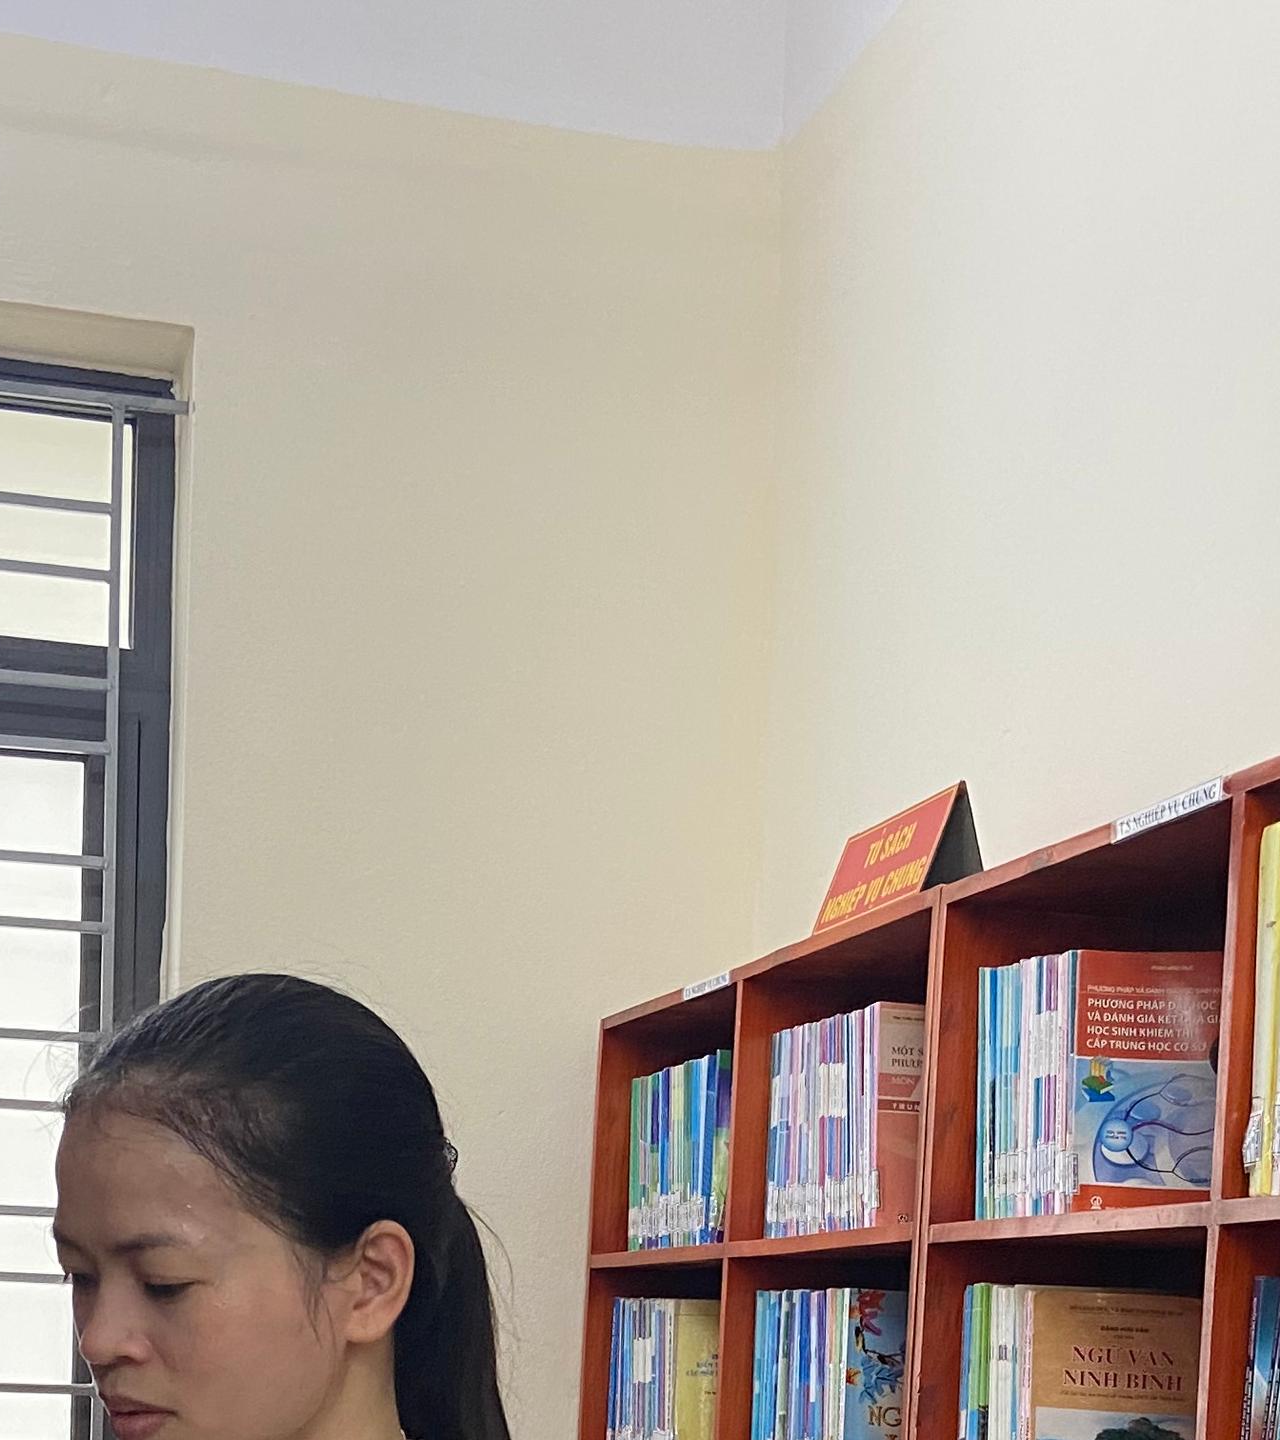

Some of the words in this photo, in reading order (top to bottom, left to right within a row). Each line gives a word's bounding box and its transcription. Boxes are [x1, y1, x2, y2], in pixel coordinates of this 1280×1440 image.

[1182, 783, 1217, 810] CHUNG
[864, 828, 886, 868] TỦ
[879, 822, 917, 861] SÁCH
[821, 881, 867, 924] NGHIỆP
[864, 875, 886, 909] VỤ
[881, 856, 927, 897] CHUNG
[1087, 997, 1134, 1010] PHƯƠNG
[1136, 999, 1166, 1010] PHÁP
[1087, 1011, 1101, 1023] VÀ
[1103, 1011, 1134, 1024] ĐÁNH
[1087, 1025, 1108, 1037] HỌC
[1111, 1026, 1138, 1037] SINH
[1110, 1040, 1146, 1050] TRUNG
[1148, 1041, 1170, 1053] HỌC
[1063, 1369, 1118, 1388] NINH
[1126, 1369, 1184, 1391] BÌNH
